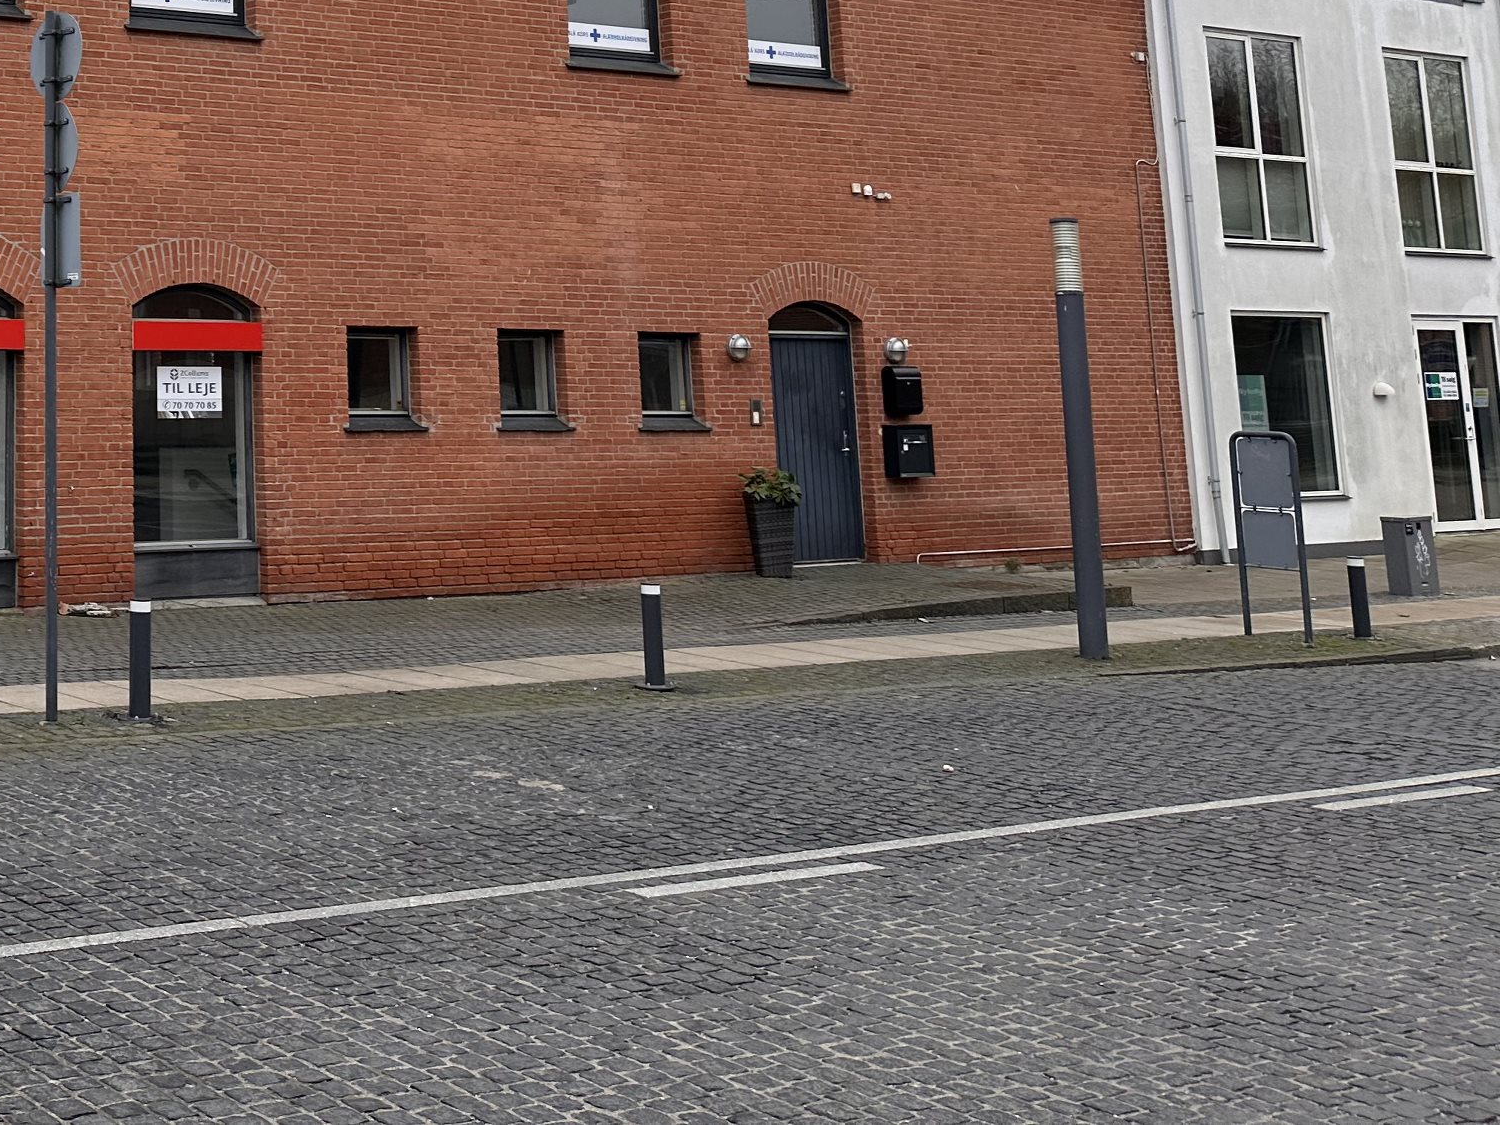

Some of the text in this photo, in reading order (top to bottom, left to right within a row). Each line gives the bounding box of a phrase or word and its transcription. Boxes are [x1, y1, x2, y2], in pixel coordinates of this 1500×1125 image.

[162, 382, 217, 397] TIL LEJE
[172, 401, 217, 410] 70 70 70 85
